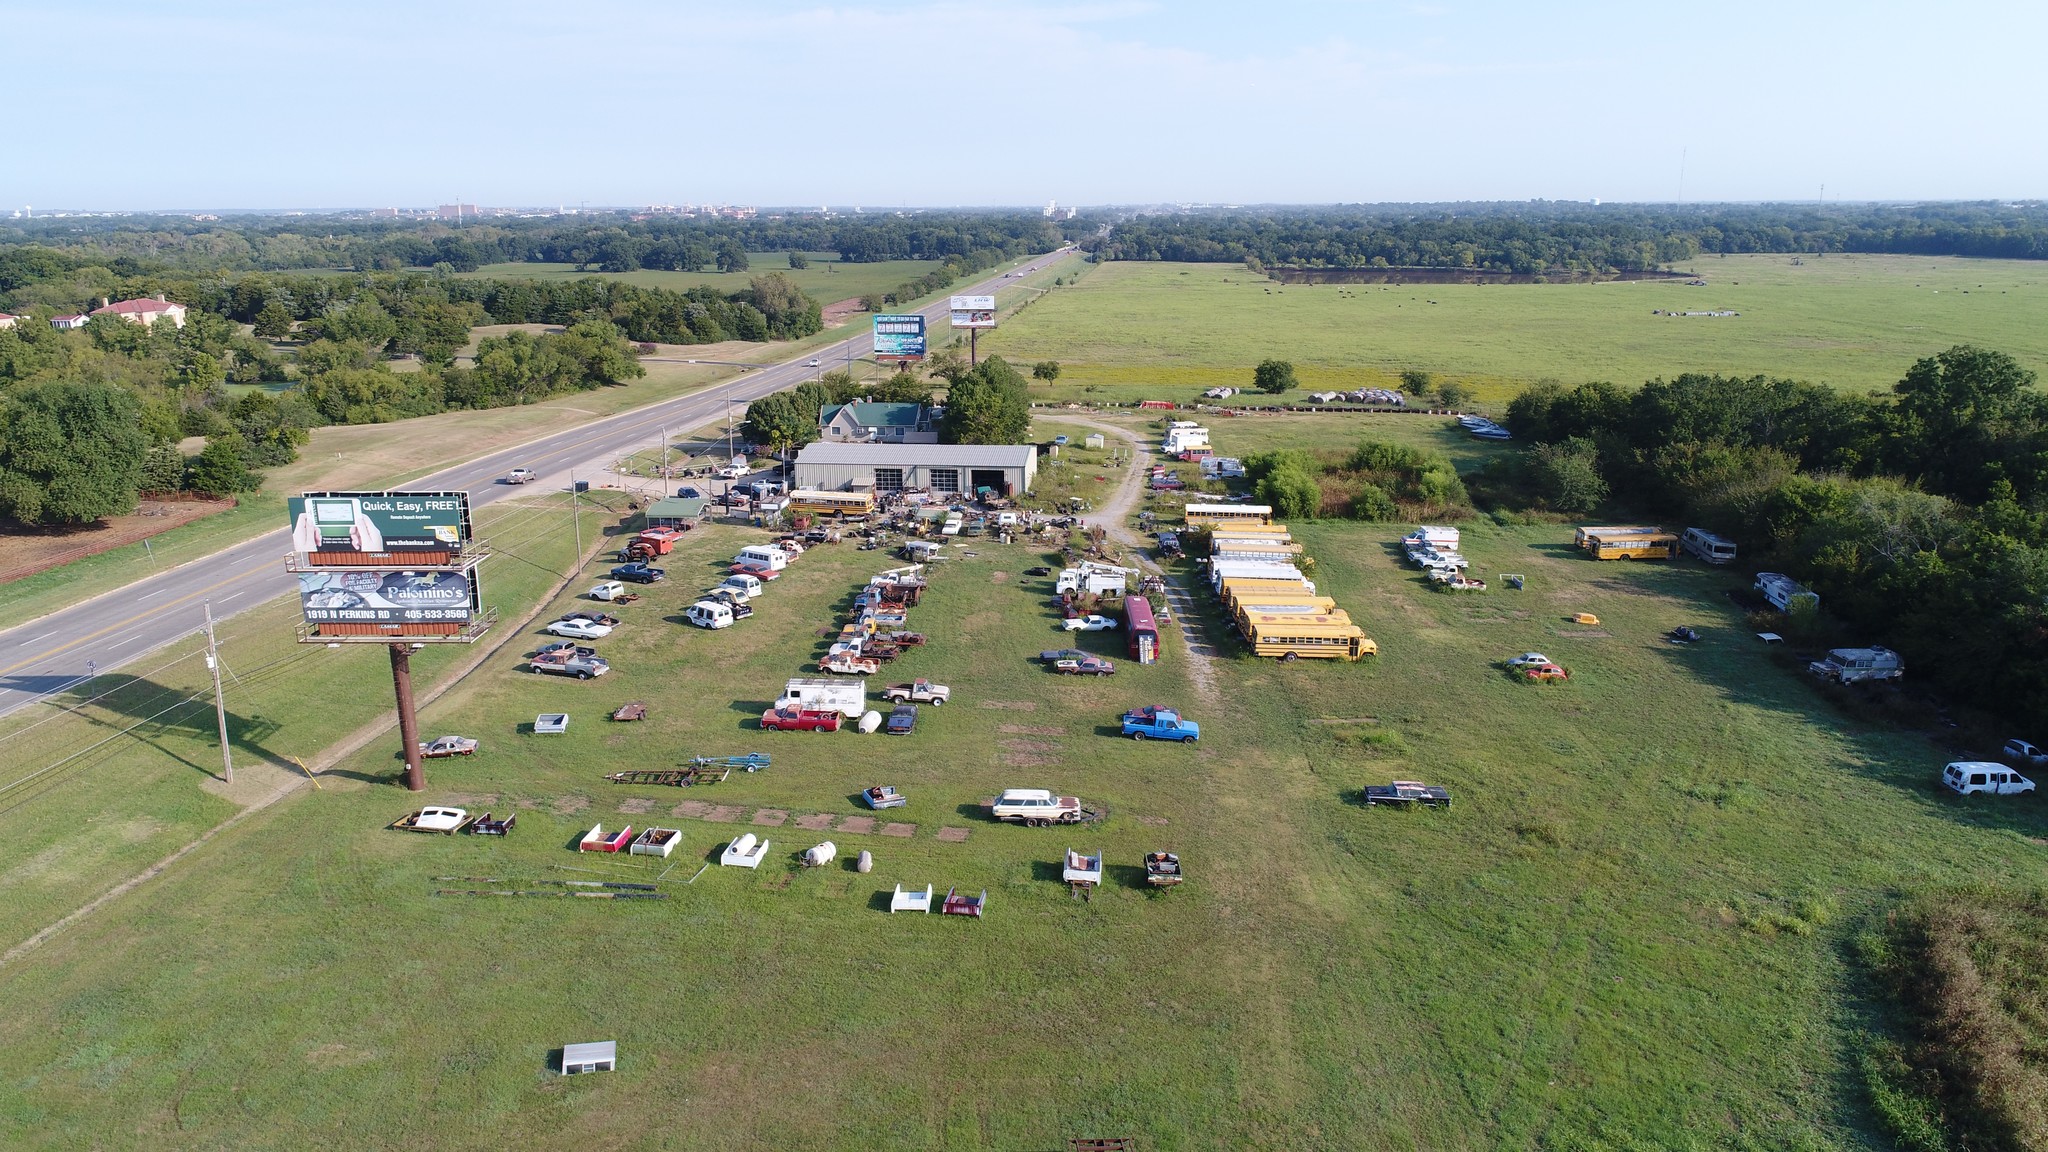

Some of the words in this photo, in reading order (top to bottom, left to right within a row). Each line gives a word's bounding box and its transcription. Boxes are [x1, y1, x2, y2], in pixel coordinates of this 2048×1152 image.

[362, 501, 395, 512] Quick,
[396, 501, 423, 512] Easy,
[387, 586, 464, 599] Palomino's
[307, 610, 328, 619] 1919
[330, 610, 338, 619] N
[339, 610, 376, 619] PERKINS
[378, 610, 390, 619] RD
